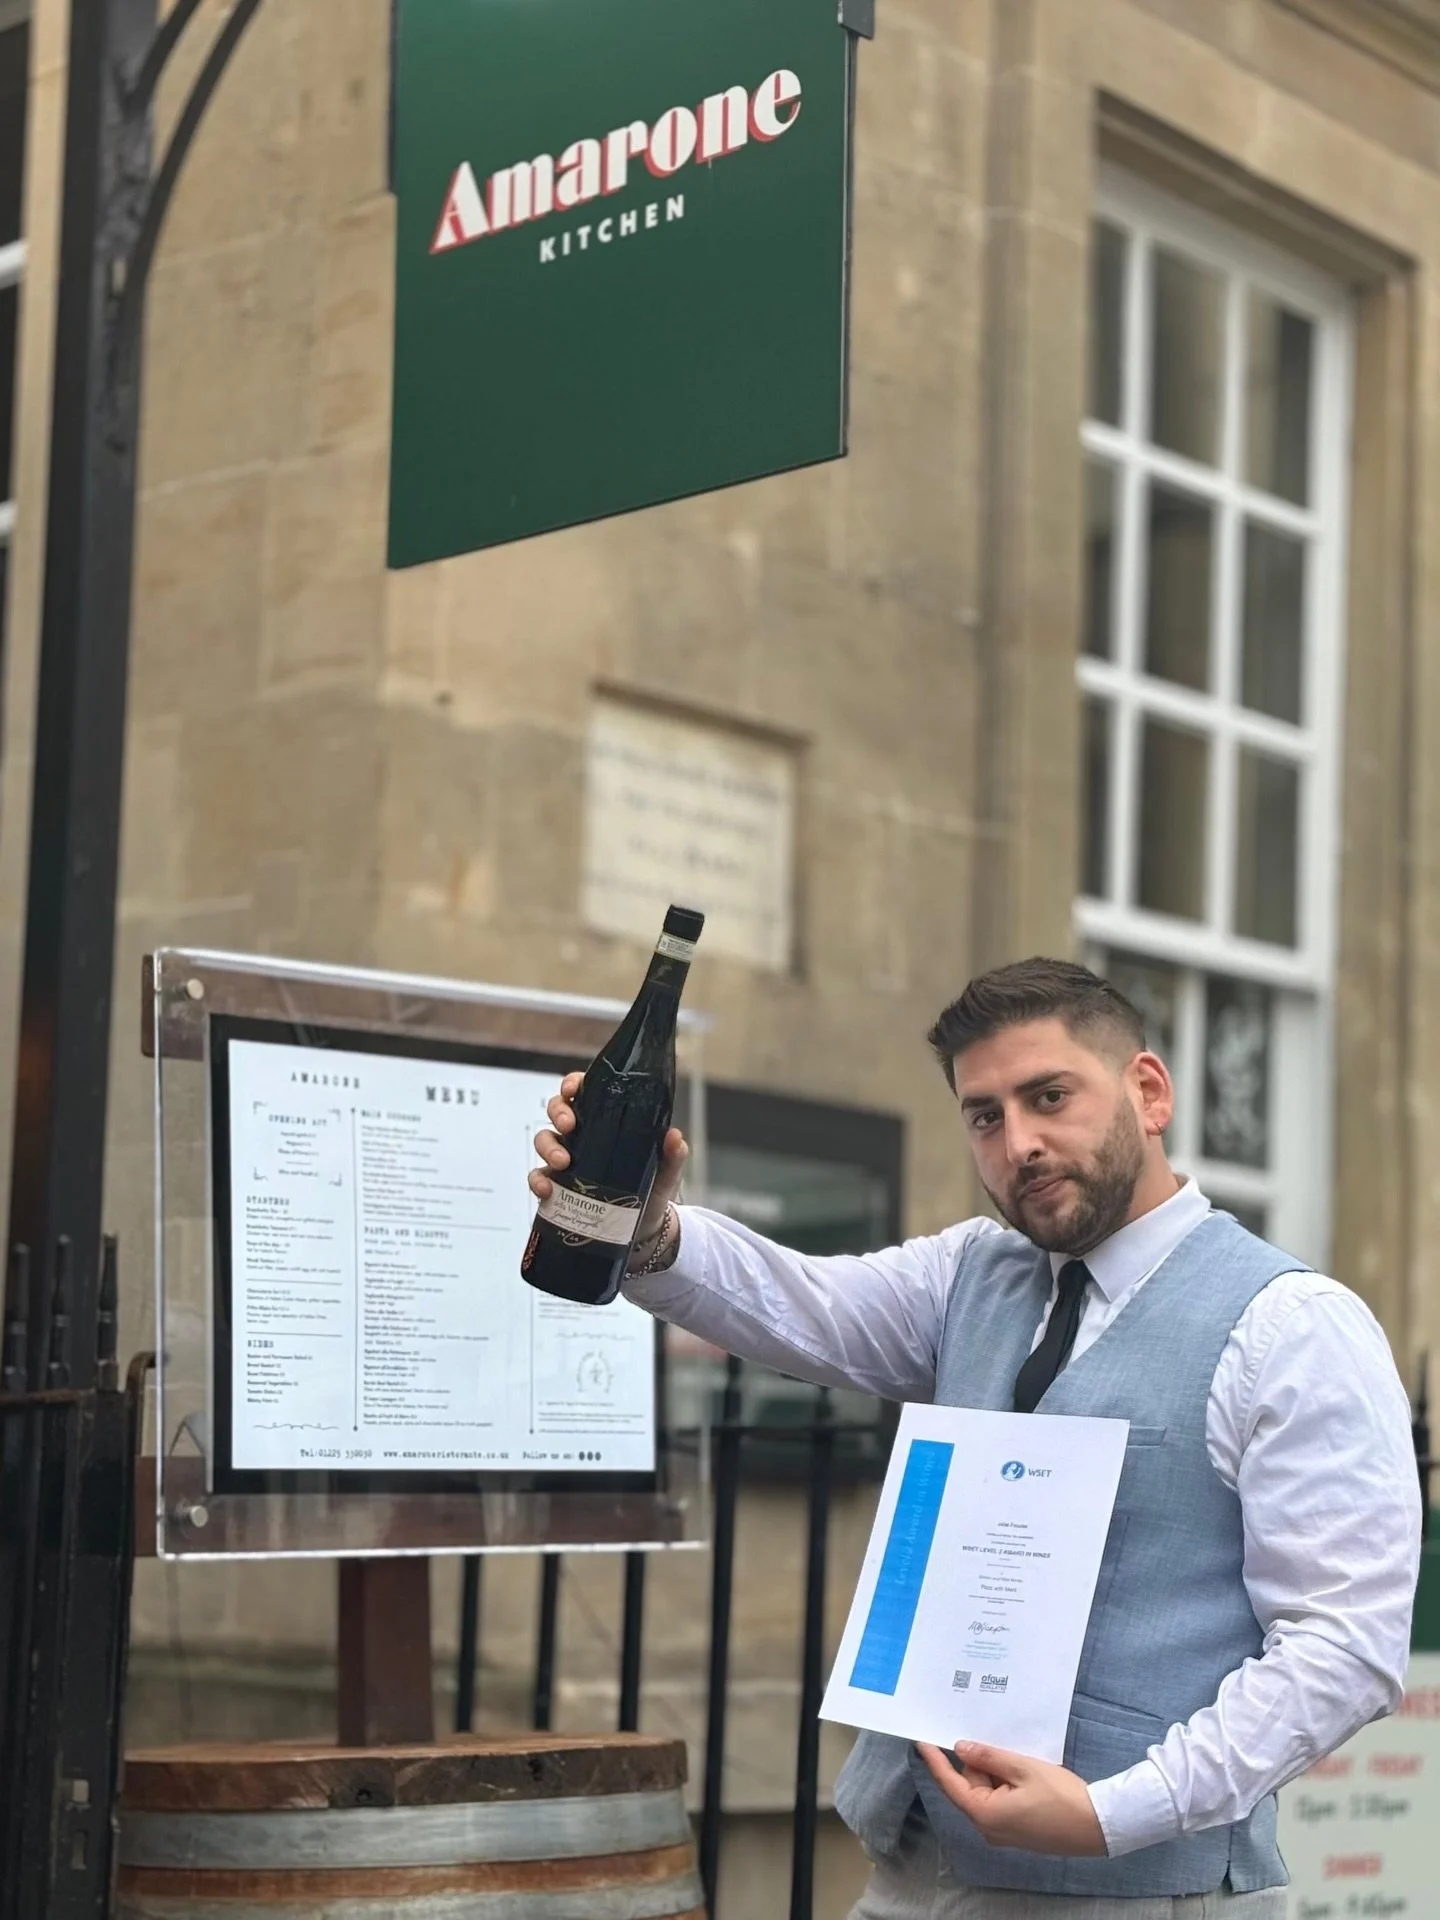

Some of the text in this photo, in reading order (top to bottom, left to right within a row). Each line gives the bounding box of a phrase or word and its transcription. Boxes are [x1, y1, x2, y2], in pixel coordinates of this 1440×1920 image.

[430, 69, 802, 254] Amarone
[539, 194, 685, 263] KITCHEN
[290, 1071, 360, 1090] AMARONE
[426, 1085, 480, 1107] MENU
[560, 1189, 606, 1216] Amarone
[1028, 1467, 1053, 1478] WSET
